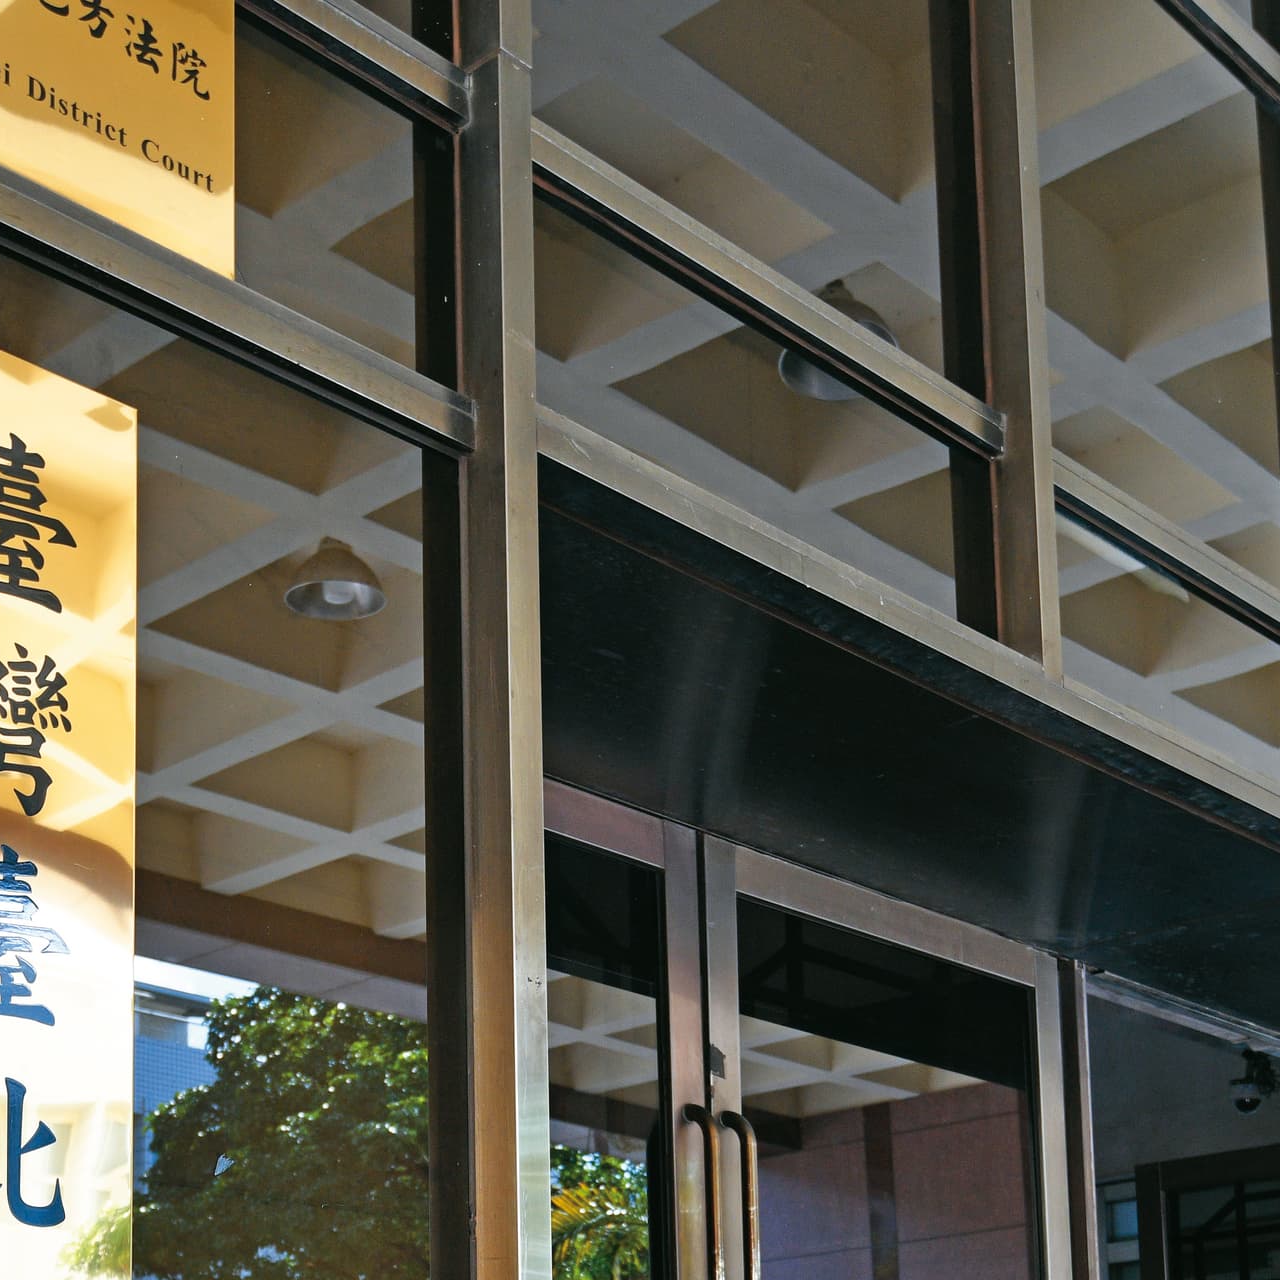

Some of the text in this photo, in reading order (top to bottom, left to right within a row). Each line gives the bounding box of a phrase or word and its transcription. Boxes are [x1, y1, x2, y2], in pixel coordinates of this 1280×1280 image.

[39, 0, 210, 101] 方法院
[26, 74, 128, 147] District
[141, 138, 214, 194] Court
